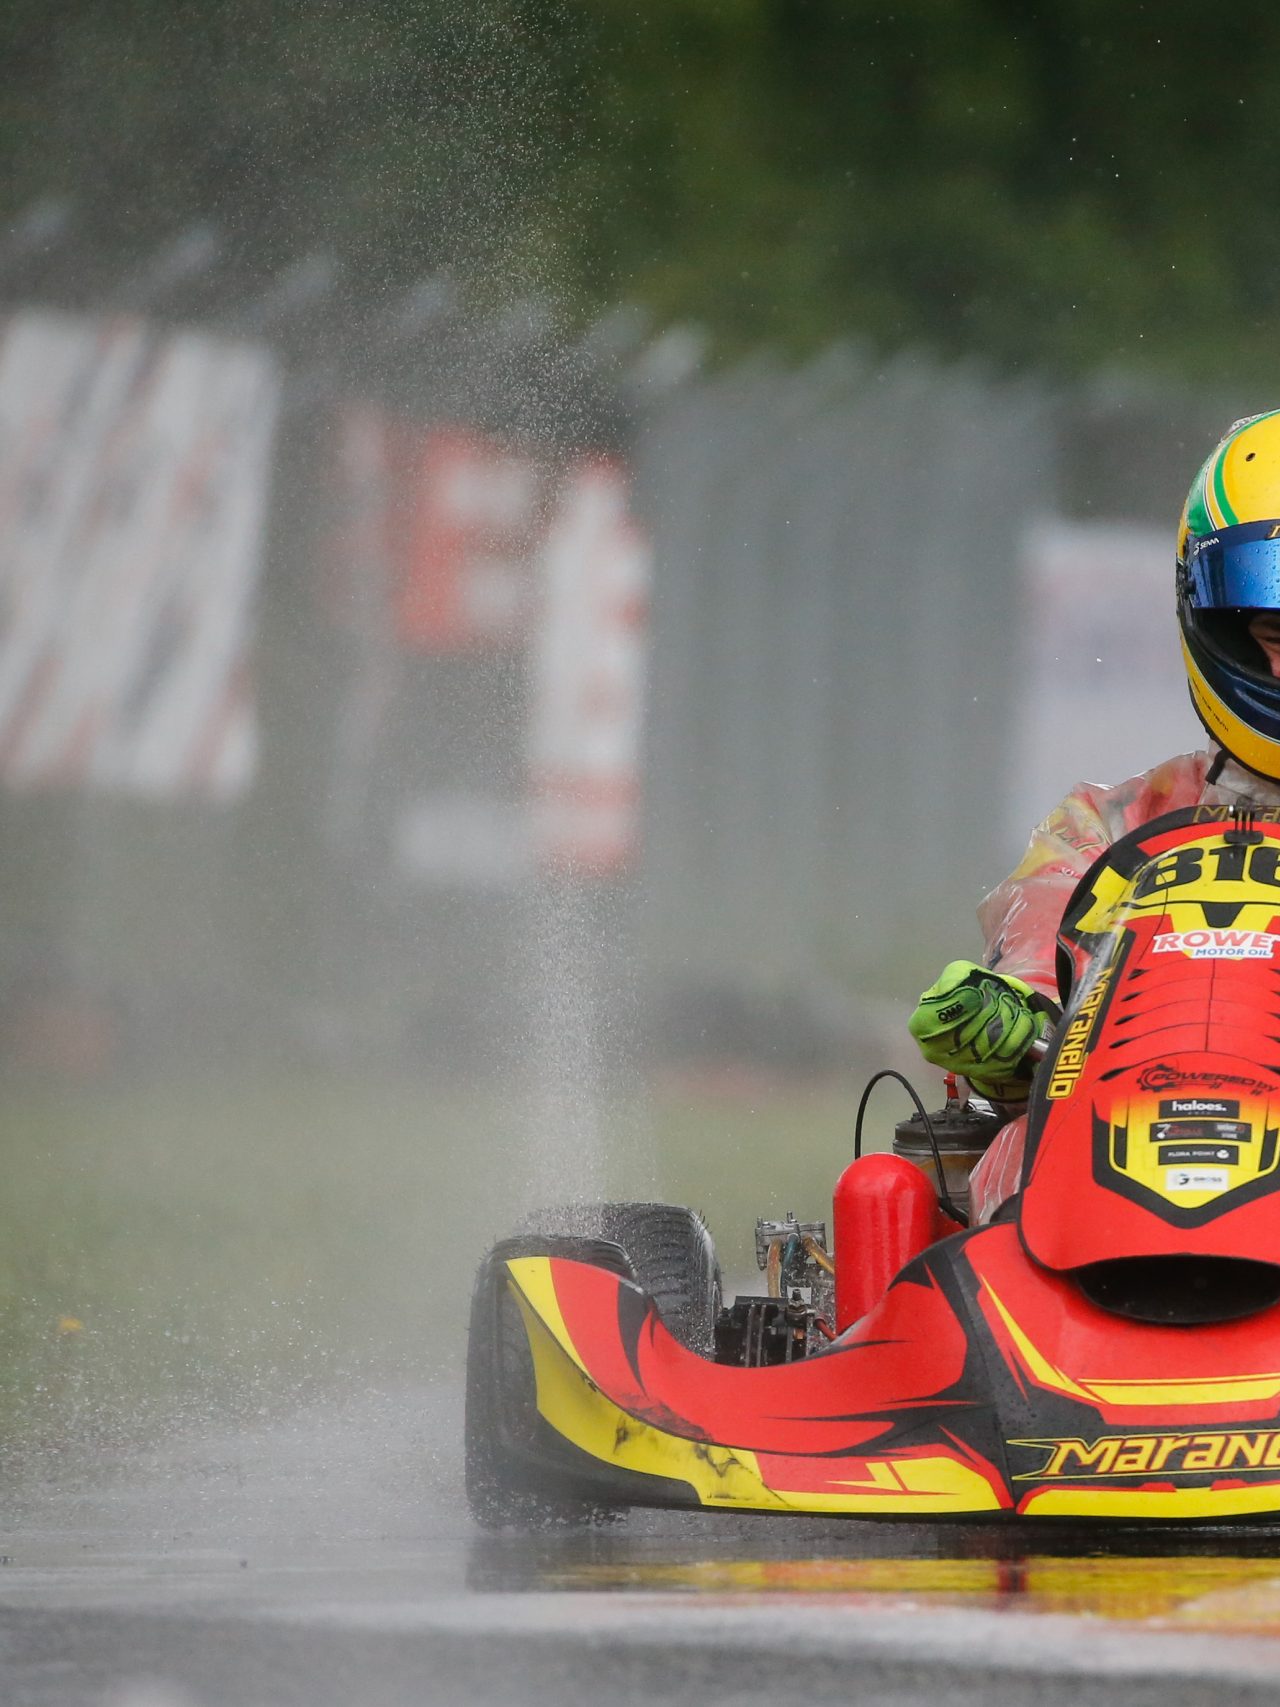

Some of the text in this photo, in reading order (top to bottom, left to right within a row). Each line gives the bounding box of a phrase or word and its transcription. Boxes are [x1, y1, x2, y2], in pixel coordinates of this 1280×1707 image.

[1157, 931, 1272, 949] ROWE
[1195, 948, 1270, 956] MOTOR OIL
[937, 1003, 964, 1023] OMP
[1172, 1100, 1227, 1111] haloes.
